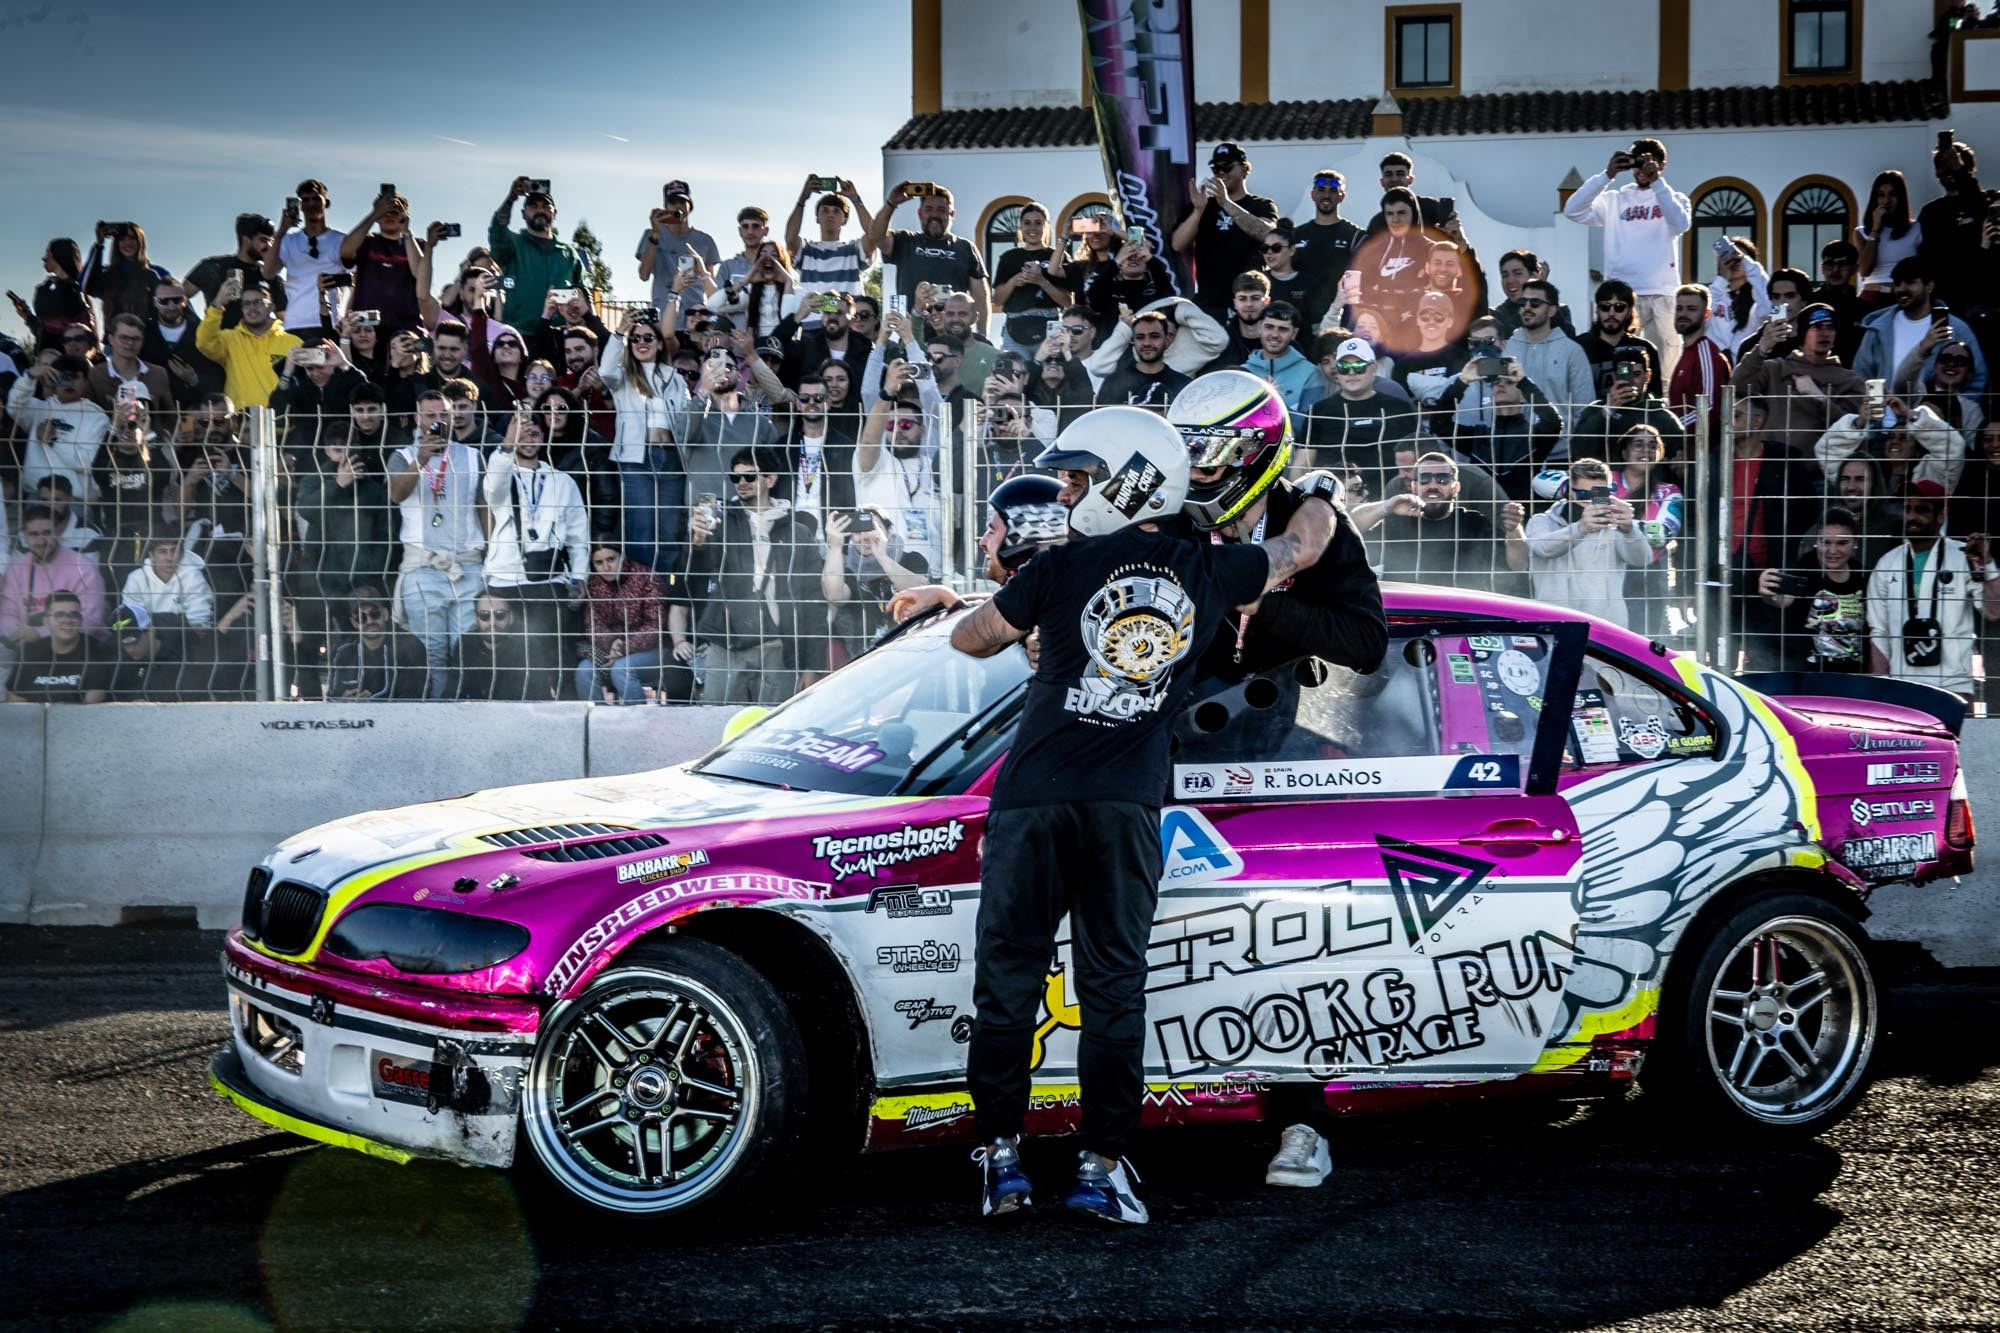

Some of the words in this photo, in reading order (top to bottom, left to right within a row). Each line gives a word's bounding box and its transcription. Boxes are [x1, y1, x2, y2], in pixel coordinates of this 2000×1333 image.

[1136, 0, 1190, 164] RIFT
[1114, 468, 1141, 510] TANDEM
[1138, 462, 1158, 493] CREW
[1264, 775, 1280, 789] R.
[1287, 768, 1382, 788] BOLAÑOS
[1468, 761, 1501, 782] 42
[812, 820, 964, 859] Tecnoshock
[641, 869, 668, 882] STICKER
[669, 866, 686, 878] SHOP
[830, 840, 957, 881] Suspensions
[888, 907, 952, 918] PERFORMANCE
[877, 940, 960, 965] STRÖM
[895, 1000, 927, 1012] GEAR
[1153, 978, 1375, 1078] LOOK
[1304, 1011, 1486, 1080] GARAGE
[378, 1057, 431, 1089] Garre
[906, 1102, 970, 1126] Milwaukee
[1060, 1091, 1081, 1108] VA
